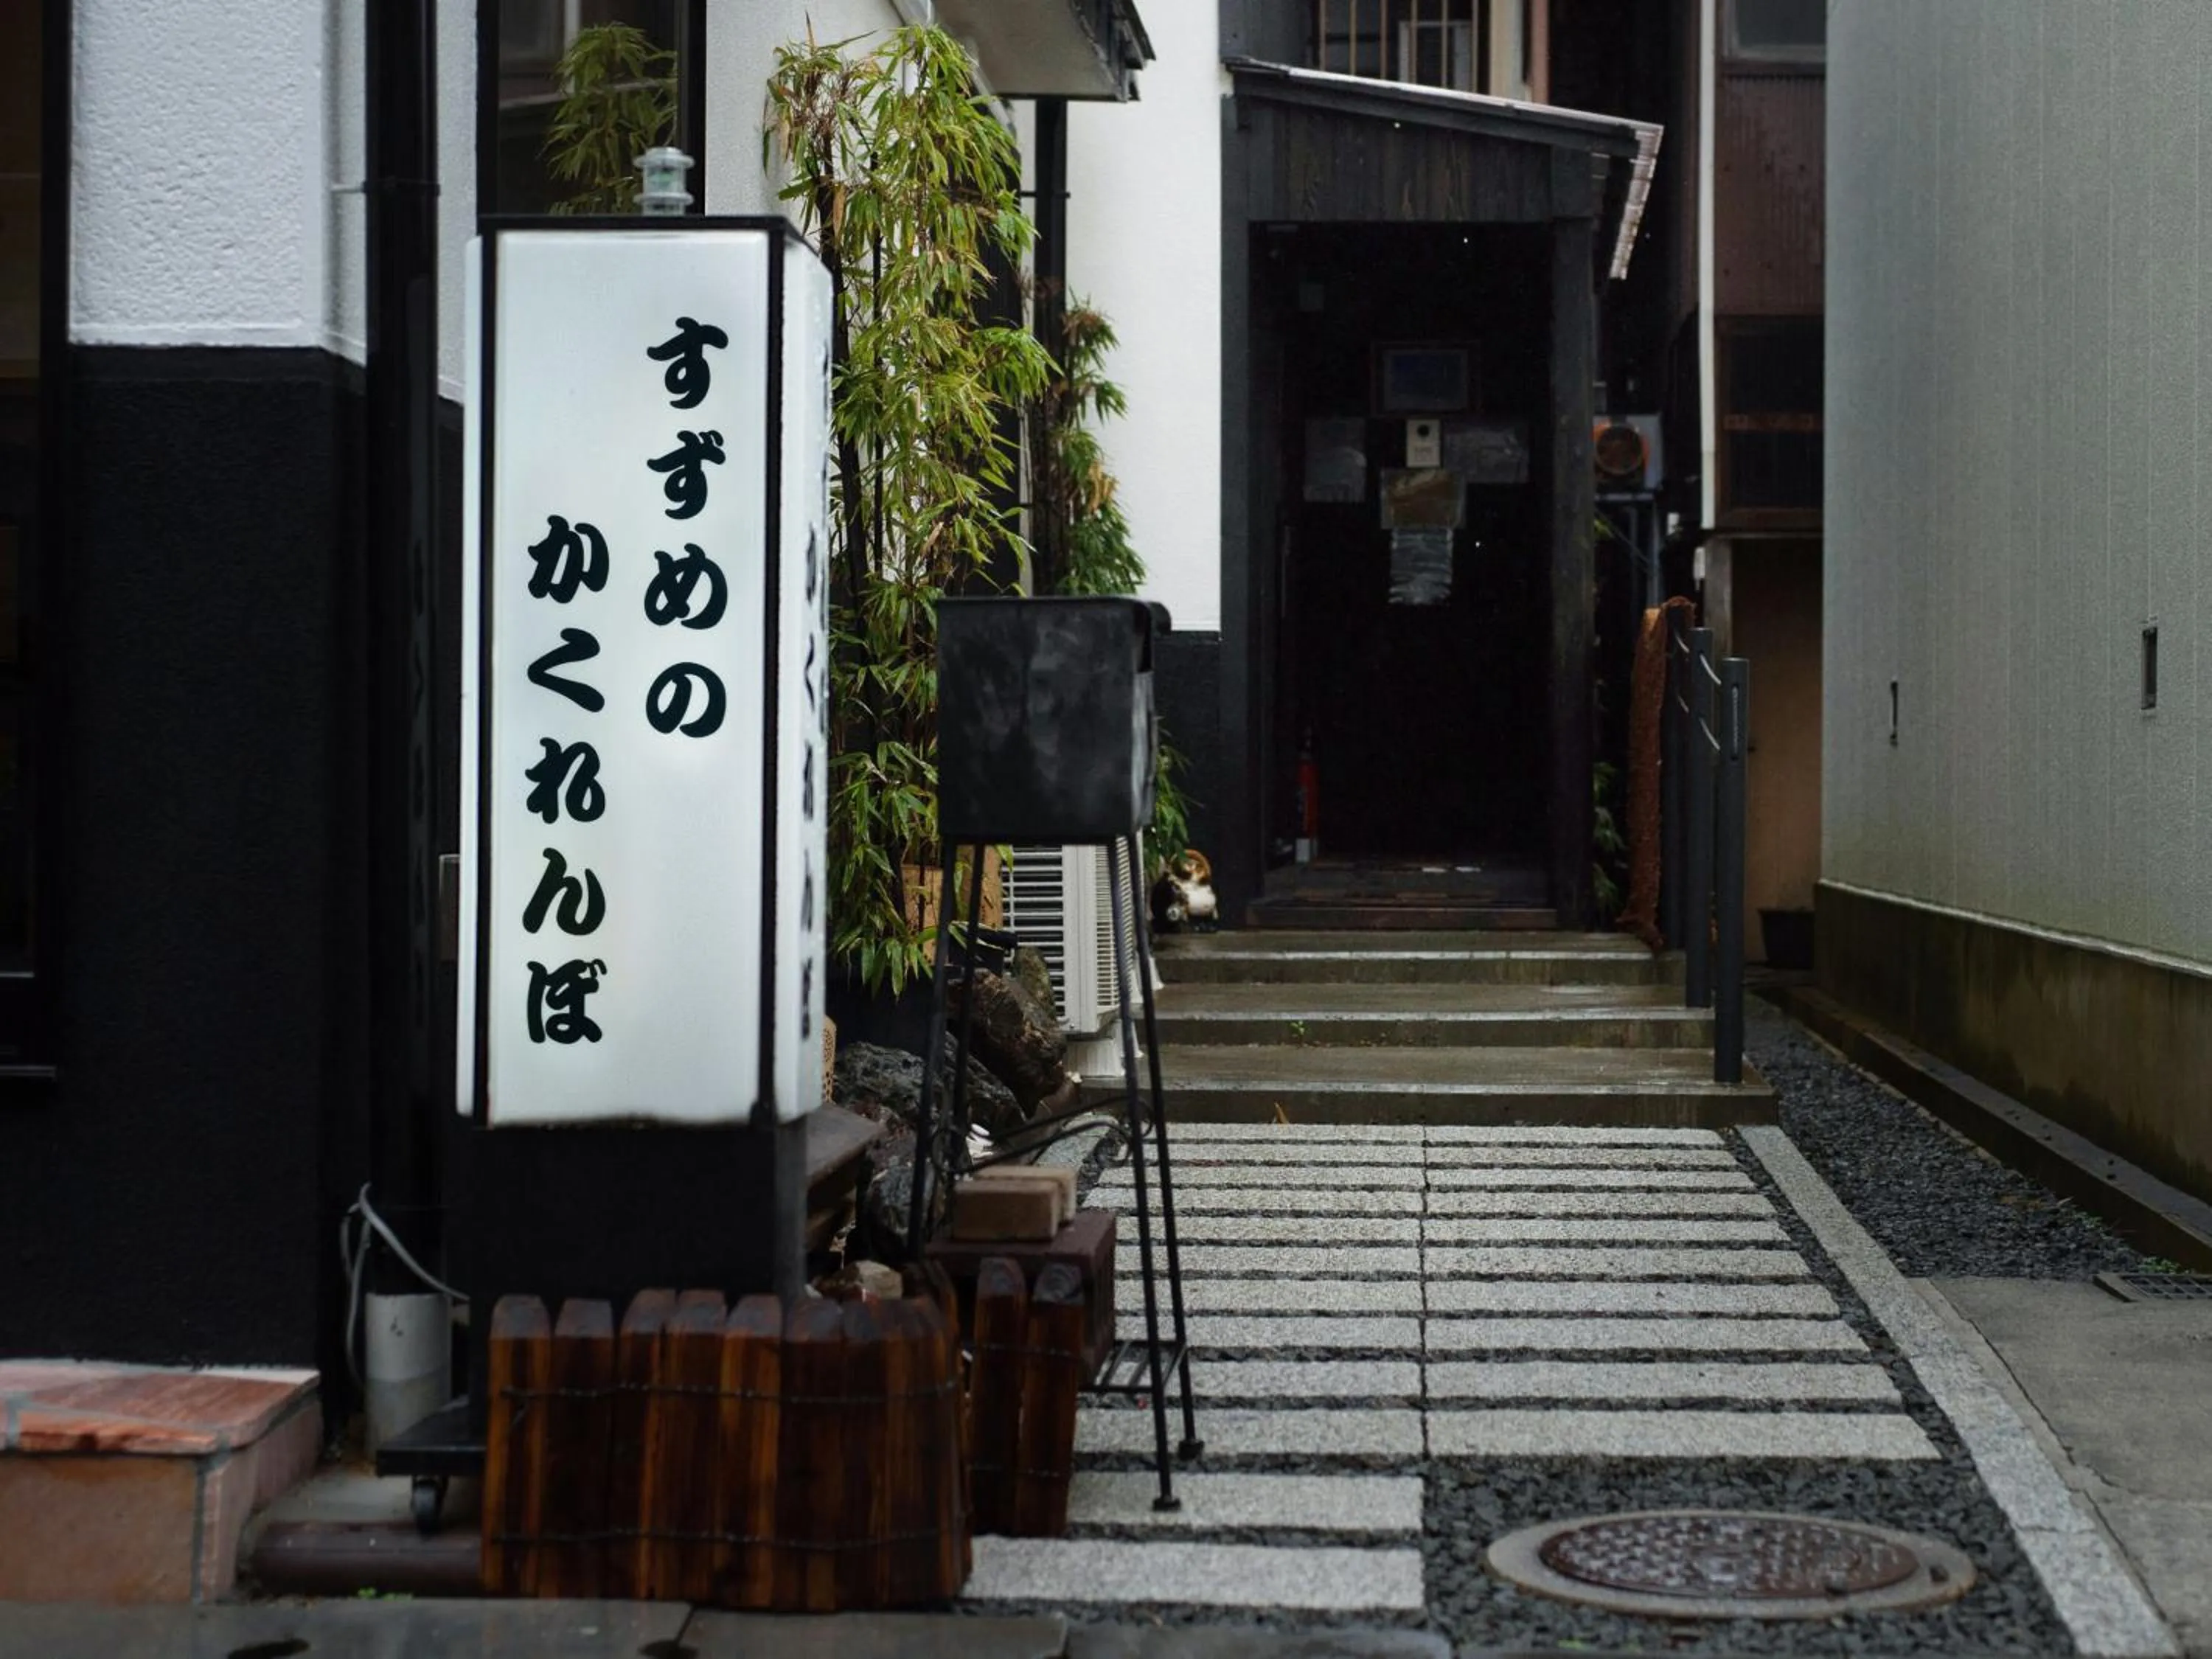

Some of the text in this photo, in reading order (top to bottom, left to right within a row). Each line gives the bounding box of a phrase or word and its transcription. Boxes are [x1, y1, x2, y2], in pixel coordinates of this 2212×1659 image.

[644, 317, 728, 737] すずめの
[523, 515, 609, 1044] かくれんぼ
